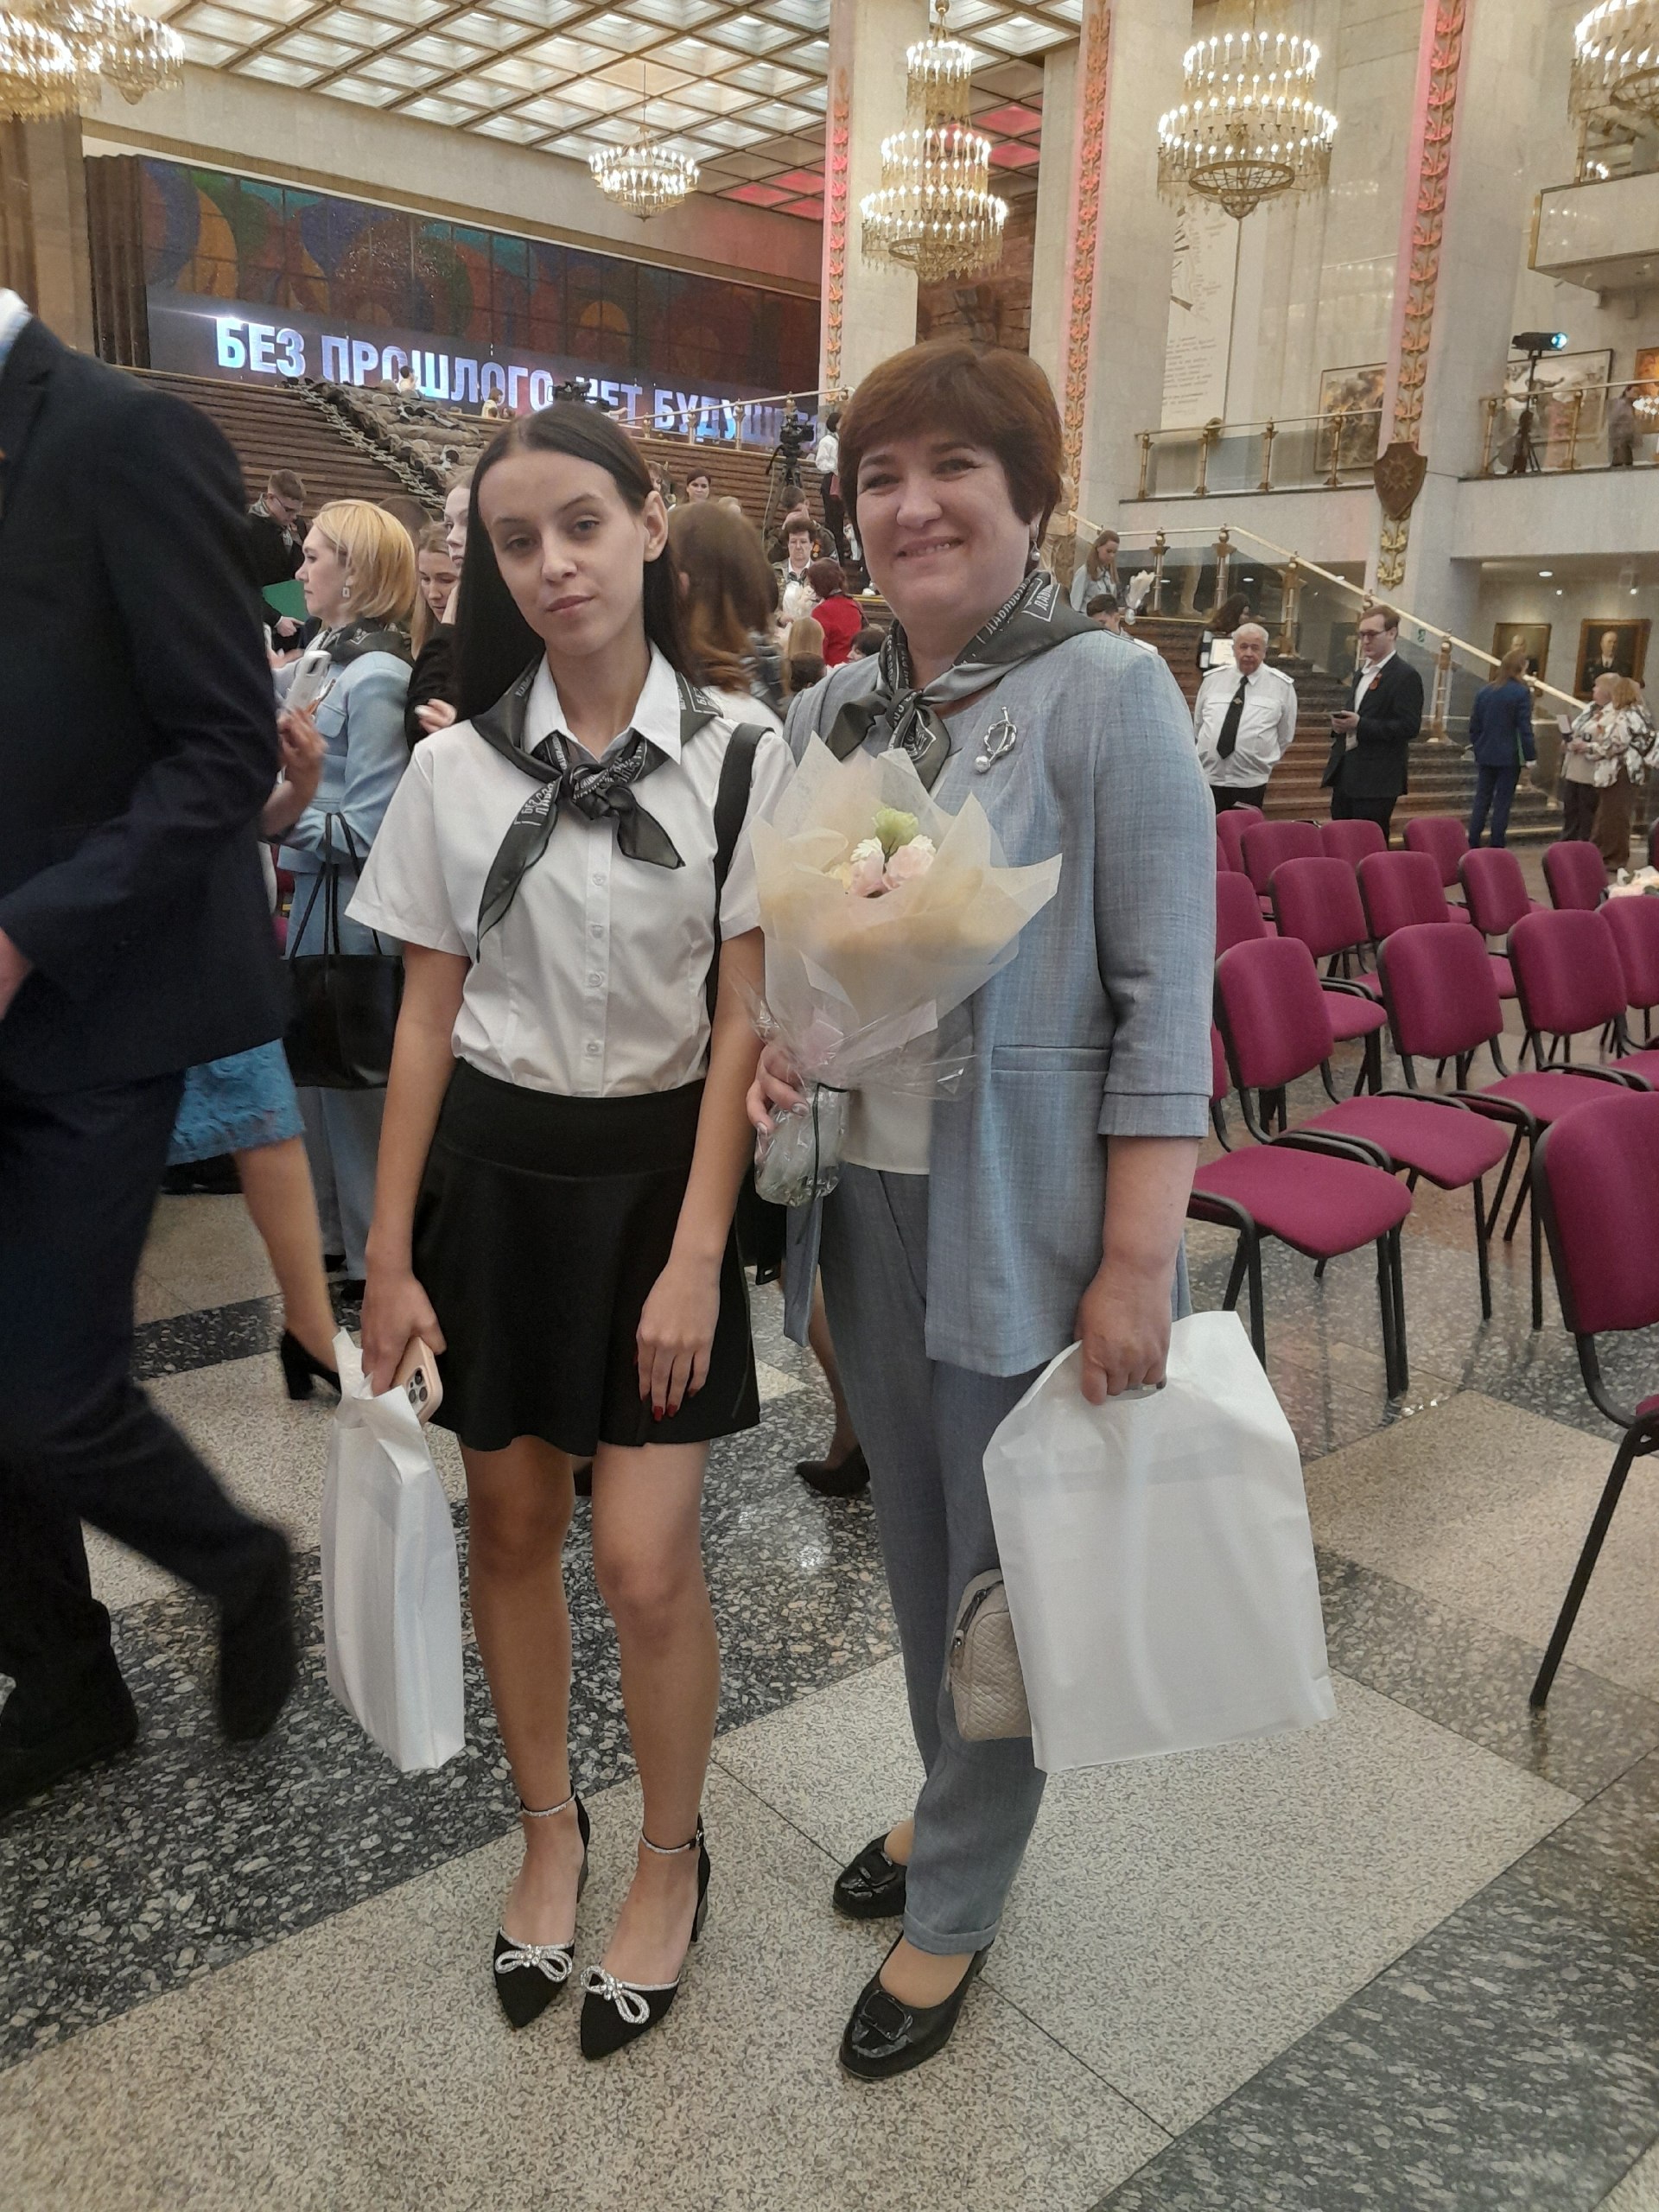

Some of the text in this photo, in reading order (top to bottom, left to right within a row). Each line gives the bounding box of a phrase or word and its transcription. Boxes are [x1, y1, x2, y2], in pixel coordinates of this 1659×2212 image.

[216, 318, 306, 378] БЕЗ
[321, 334, 554, 412] ПРОШЛОГО
[654, 389, 818, 449] БУДУЩ
